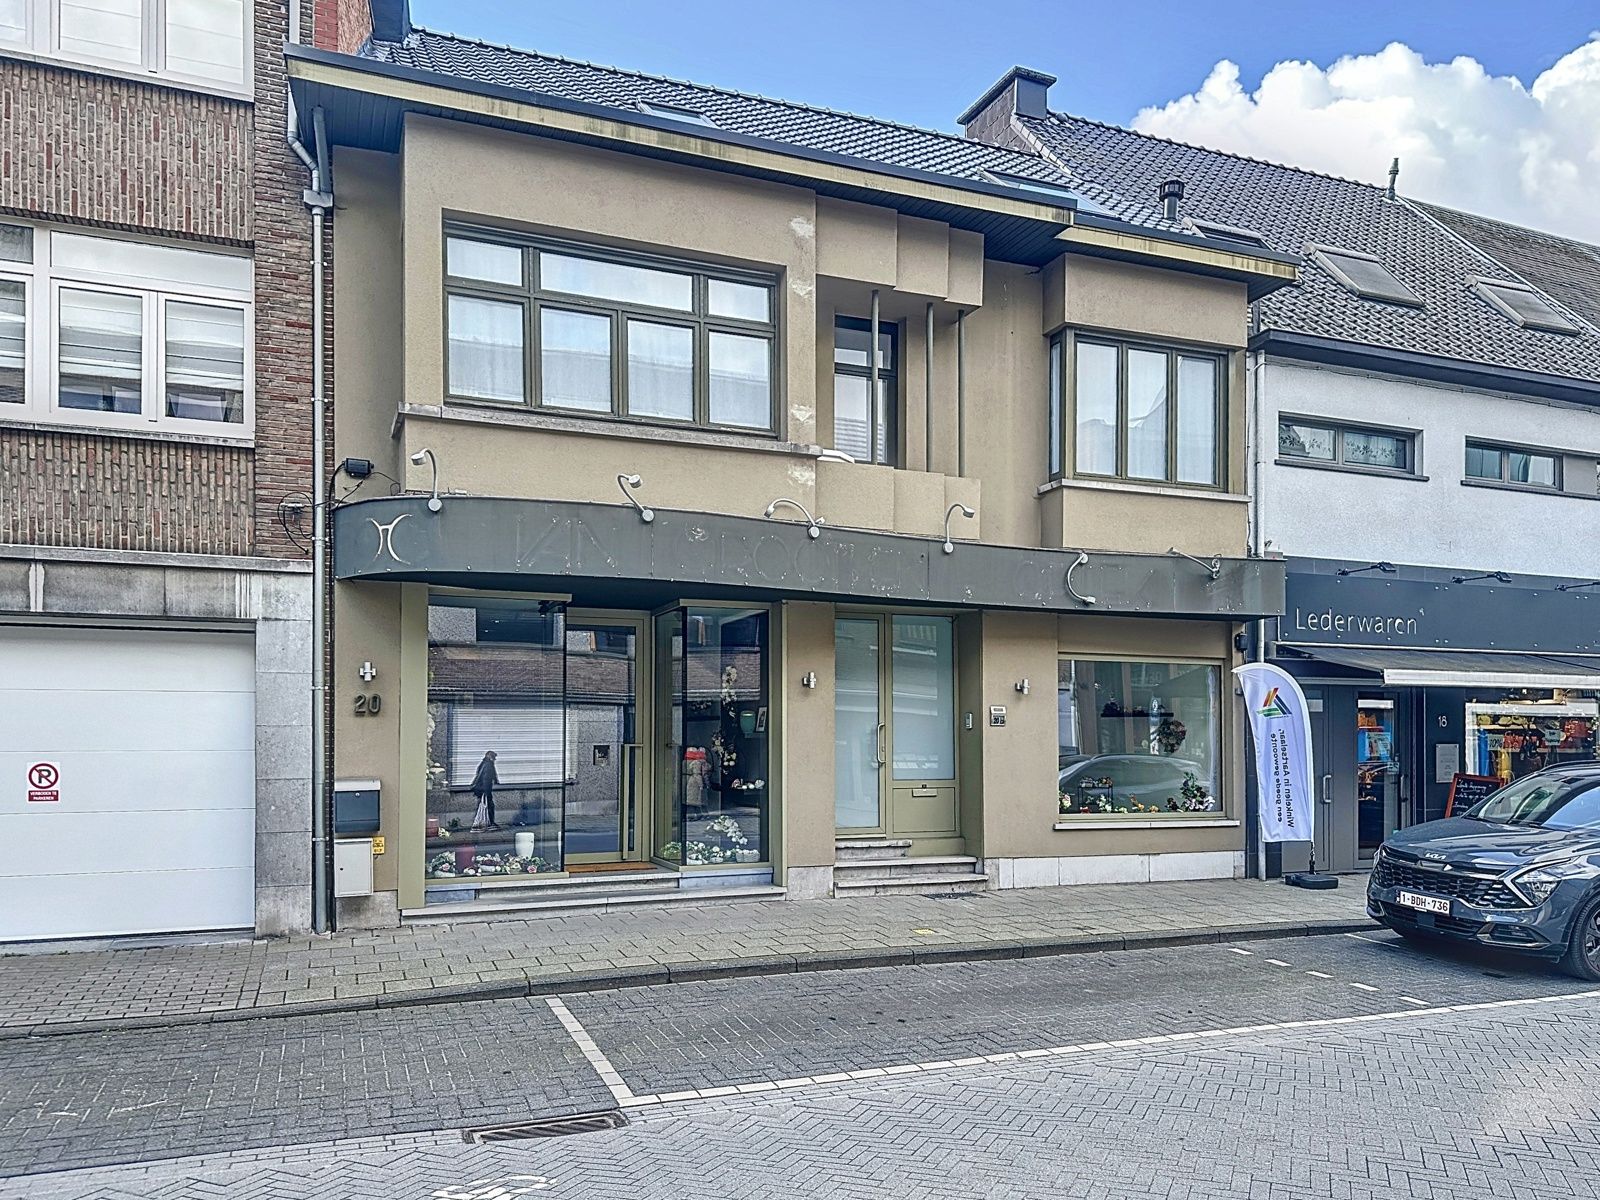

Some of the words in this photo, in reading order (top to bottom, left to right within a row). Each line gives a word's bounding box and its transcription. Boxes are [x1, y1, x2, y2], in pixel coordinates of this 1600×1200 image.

[1296, 607, 1417, 635] Lederwaren
[354, 694, 381, 714] 20
[1438, 715, 1448, 727] 18
[1402, 893, 1449, 912] 1-BDH-736
